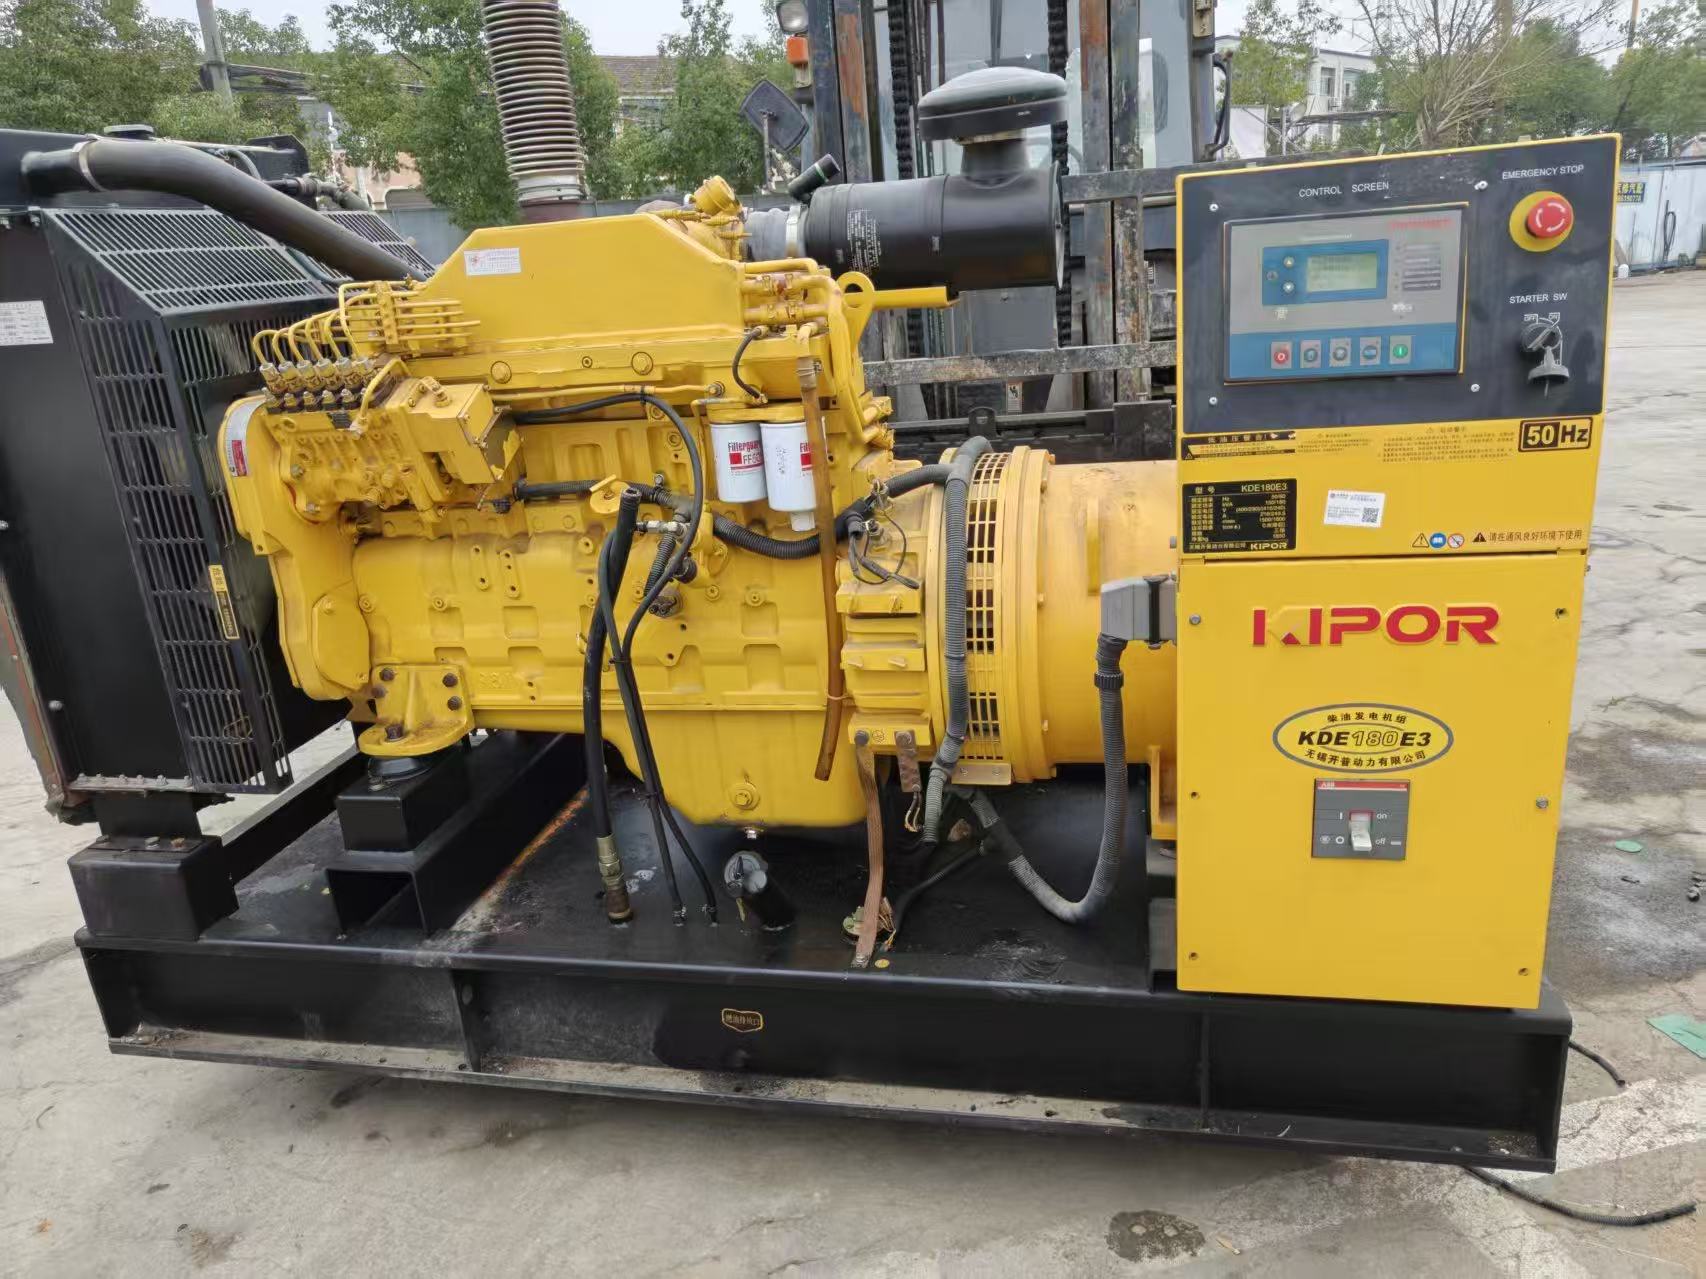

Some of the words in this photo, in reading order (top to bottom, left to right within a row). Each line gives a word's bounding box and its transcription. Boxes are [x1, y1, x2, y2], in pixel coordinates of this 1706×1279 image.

[1502, 167, 1558, 180] EMERGENCY
[1559, 164, 1584, 174] STOP
[1298, 186, 1342, 198] CONTROL
[1351, 181, 1389, 193] SCREEN
[1509, 294, 1549, 304] STARTER
[1552, 292, 1568, 301] SW
[1526, 424, 1555, 445] 50
[1560, 425, 1589, 443] Hz
[1241, 483, 1287, 492] KDE180E3
[1489, 530, 1583, 542] 请在通风良好环境下使用
[1252, 604, 1500, 646] KIPOR
[1327, 711, 1408, 724] 柴油发电机组
[1297, 730, 1432, 747] KDE180E3
[1304, 749, 1427, 767] 无锡开普动力有限公司
[1375, 837, 1386, 845] off
